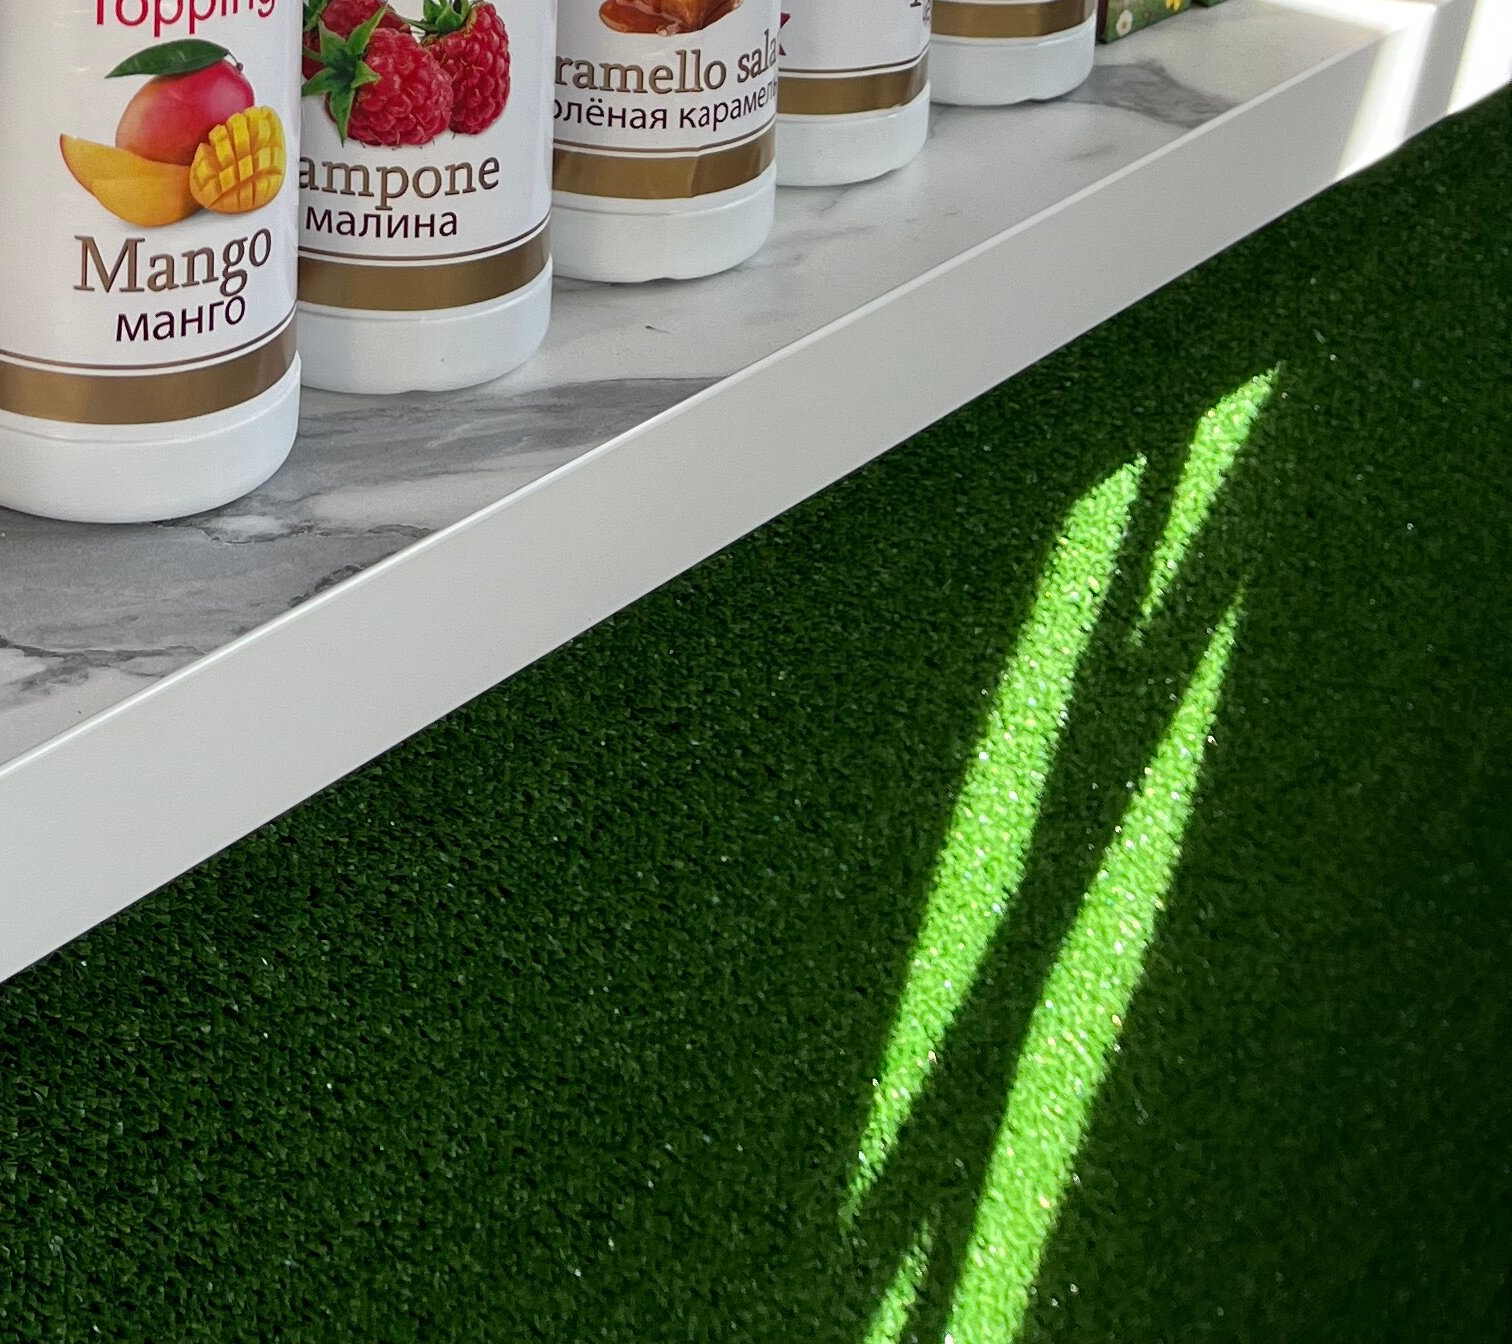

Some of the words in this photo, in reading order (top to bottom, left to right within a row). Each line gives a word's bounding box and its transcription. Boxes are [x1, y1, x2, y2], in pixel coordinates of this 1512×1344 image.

[305, 205, 459, 239] малина
[73, 227, 272, 297] Mango
[115, 294, 247, 343] манго
